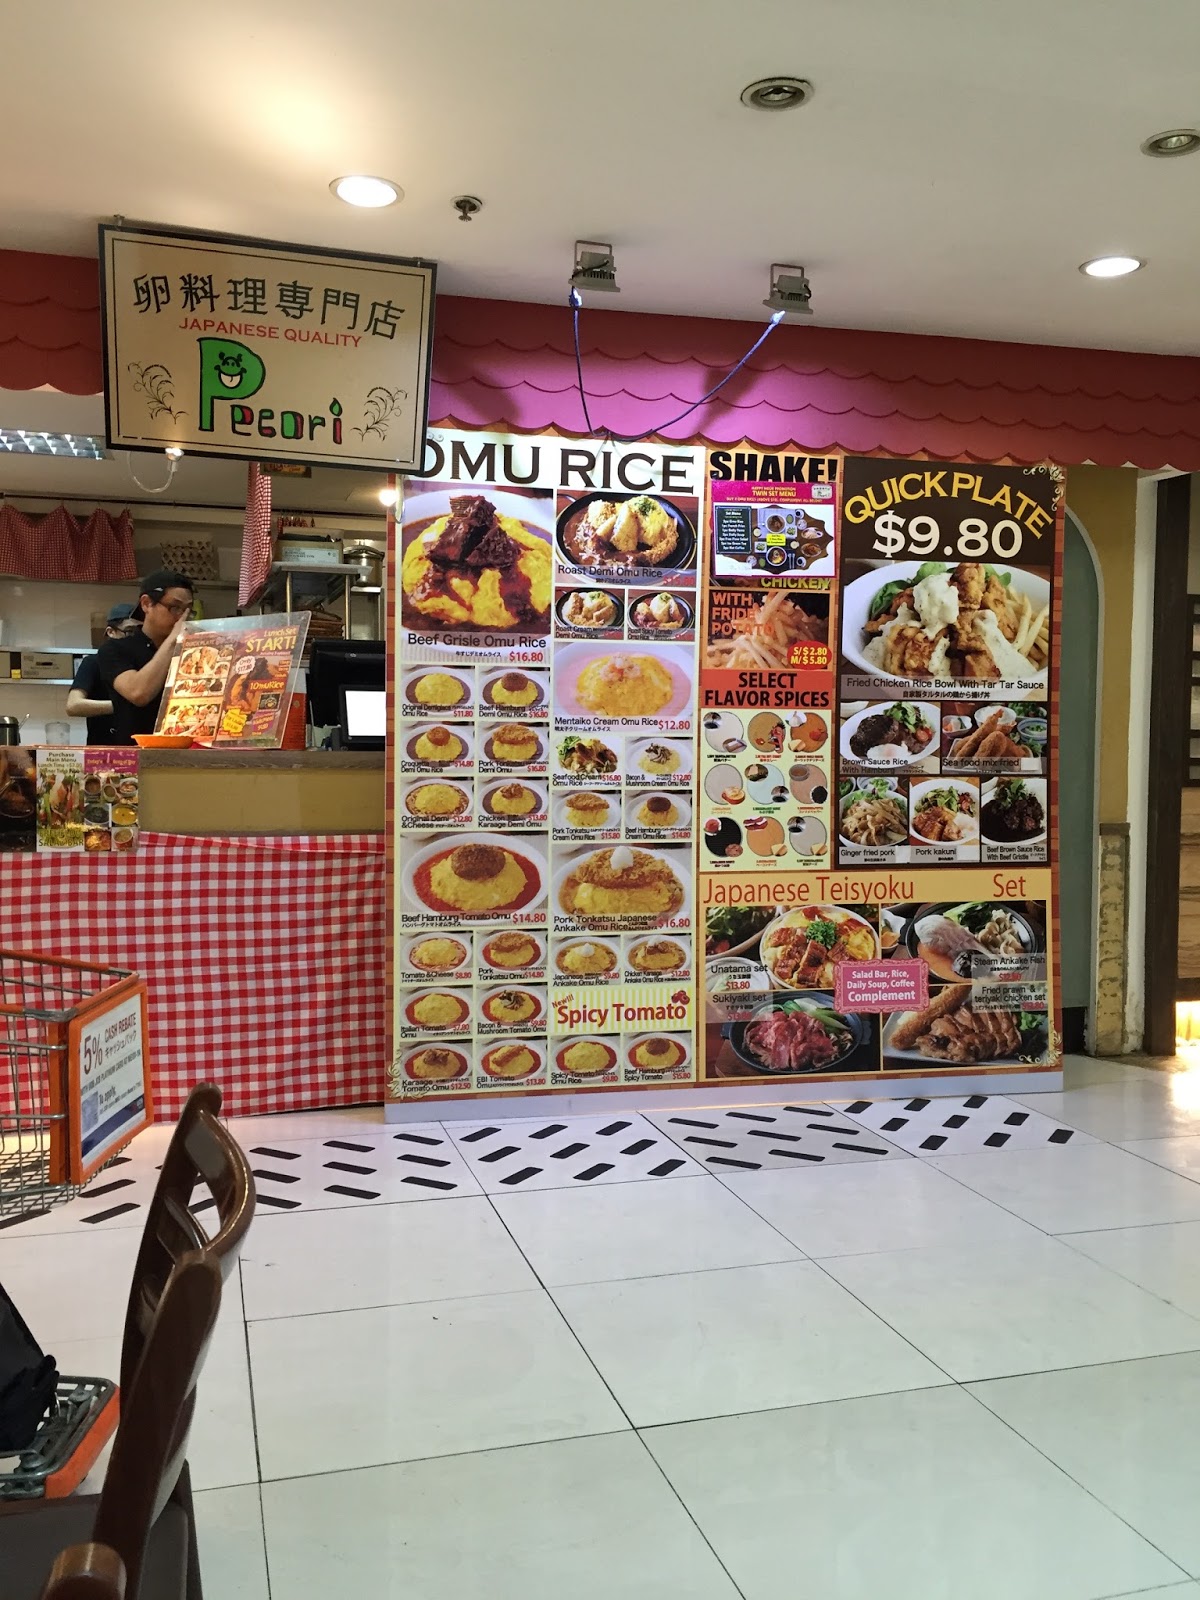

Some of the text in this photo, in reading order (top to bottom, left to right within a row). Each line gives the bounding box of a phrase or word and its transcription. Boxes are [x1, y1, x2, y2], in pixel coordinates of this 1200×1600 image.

[133, 273, 405, 340] 卵料理専門店
[179, 317, 361, 348] JAPANESE QUALITY
[559, 448, 694, 494] RICE
[710, 451, 838, 483] SHAKE!
[845, 471, 1054, 539] QUICK PLATE
[872, 510, 1023, 558] $9.80
[558, 565, 663, 578] Roast Demi Omu Rice
[761, 578, 830, 590] CHICKEN
[712, 592, 753, 606] WITH
[246, 636, 297, 653] START!
[408, 633, 546, 648] Beef Grisle Omu Rice
[509, 651, 544, 662] $16.80
[738, 672, 797, 689] SELECT
[847, 678, 1044, 689] Fried Chicken Rice Bowl With Tar Tar Sauce
[705, 690, 830, 708] FLAVOR SPICES
[454, 710, 473, 718] $11.80
[554, 717, 659, 726] Mentaiko Cream Omu Rice
[658, 720, 691, 730] $12.80
[942, 757, 1020, 767] Sea food mix fried
[862, 767, 895, 775] Hamburg
[602, 774, 622, 782] $16.80
[401, 815, 430, 823] Original
[841, 848, 895, 859] Ginger fried pork
[916, 847, 957, 856] Pork kakuni
[703, 873, 1027, 907] Japanese Teisyoku Set
[401, 914, 421, 922] Beef
[421, 913, 459, 923] Hamburg
[460, 913, 491, 921] Tomato
[512, 913, 546, 924] $14.80
[554, 914, 657, 924] Pork Tonkatsu Japanese
[658, 918, 691, 929] $16.80
[554, 923, 628, 932] Ankake Omu Rice
[711, 964, 769, 974] Unatama set
[852, 969, 909, 980] Salad Bar, Rice,
[726, 981, 750, 990] $13.80
[847, 979, 915, 990] Daily Soup, Coffee
[982, 985, 1036, 995] Fried prawn &
[712, 993, 767, 1004] Sukiyaki set
[848, 990, 916, 1003] Complement
[557, 1003, 687, 1028] Spicy Tomato
[104, 1012, 137, 1043] CASH REBATE
[84, 1033, 103, 1075] 5%
